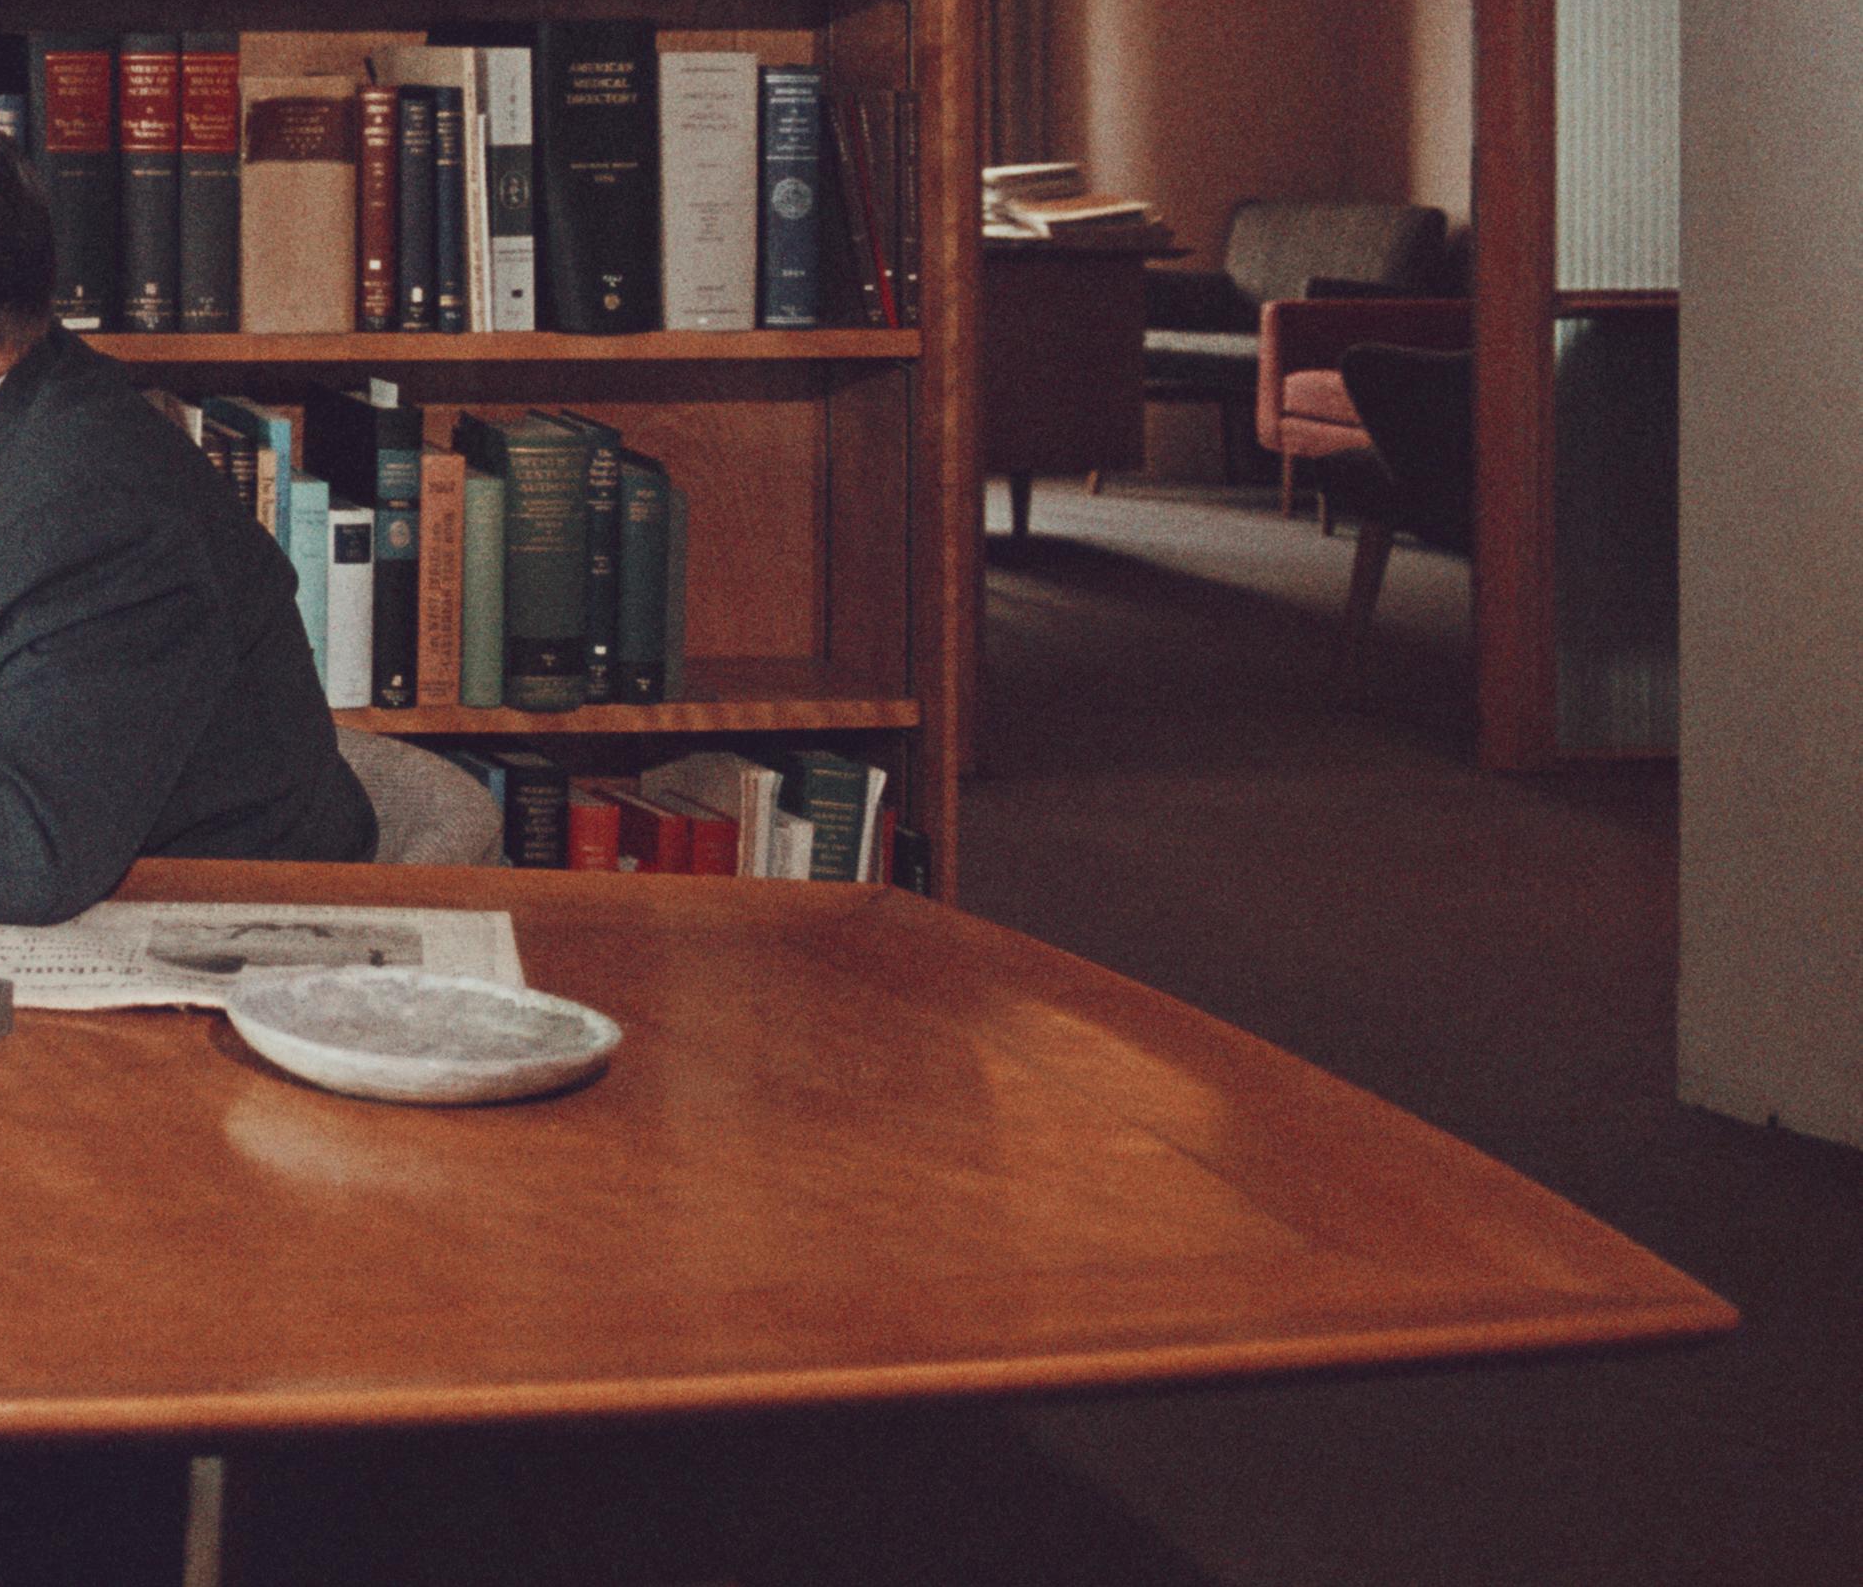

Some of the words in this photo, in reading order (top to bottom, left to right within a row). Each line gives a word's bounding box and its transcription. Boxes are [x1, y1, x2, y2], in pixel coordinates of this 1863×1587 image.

[567, 62, 635, 74] AMERICAN
[573, 78, 630, 89] MEDICAL
[566, 94, 638, 106] DIRECTORY
[12, 965, 143, 976] Tribune
